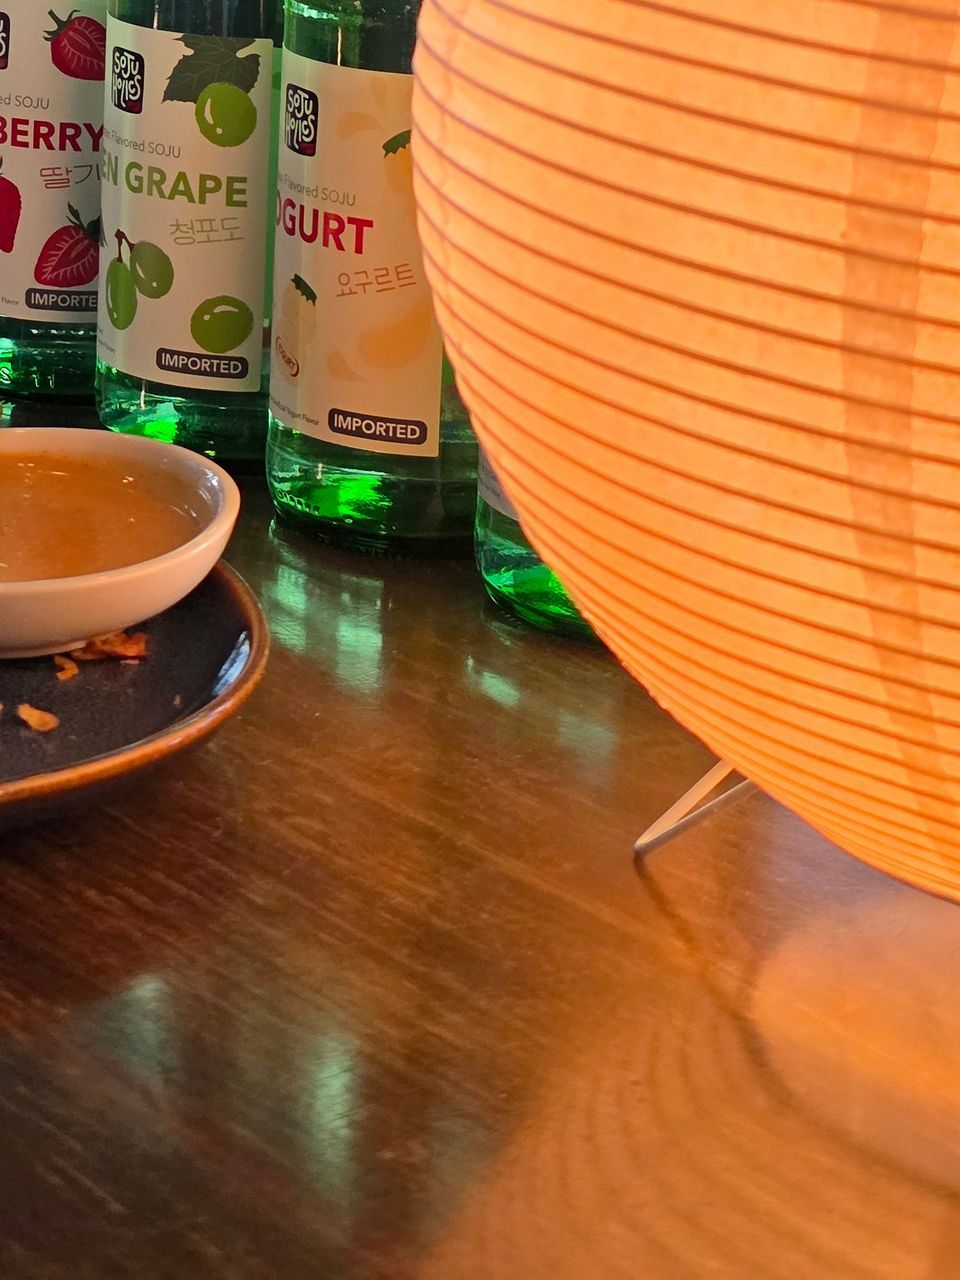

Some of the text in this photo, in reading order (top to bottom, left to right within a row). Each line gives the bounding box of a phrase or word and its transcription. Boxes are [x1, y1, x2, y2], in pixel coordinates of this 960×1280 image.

[14, 94, 50, 110] SOJU
[148, 141, 181, 159] SOJU
[39, 163, 101, 190] 딸기
[124, 161, 249, 208] GRAPE
[321, 187, 356, 207] SOJU
[168, 216, 244, 247] 청포도
[335, 262, 417, 298] 요구르트
[161, 352, 242, 374] IMPORTED
[334, 413, 420, 439] IMPORTED
